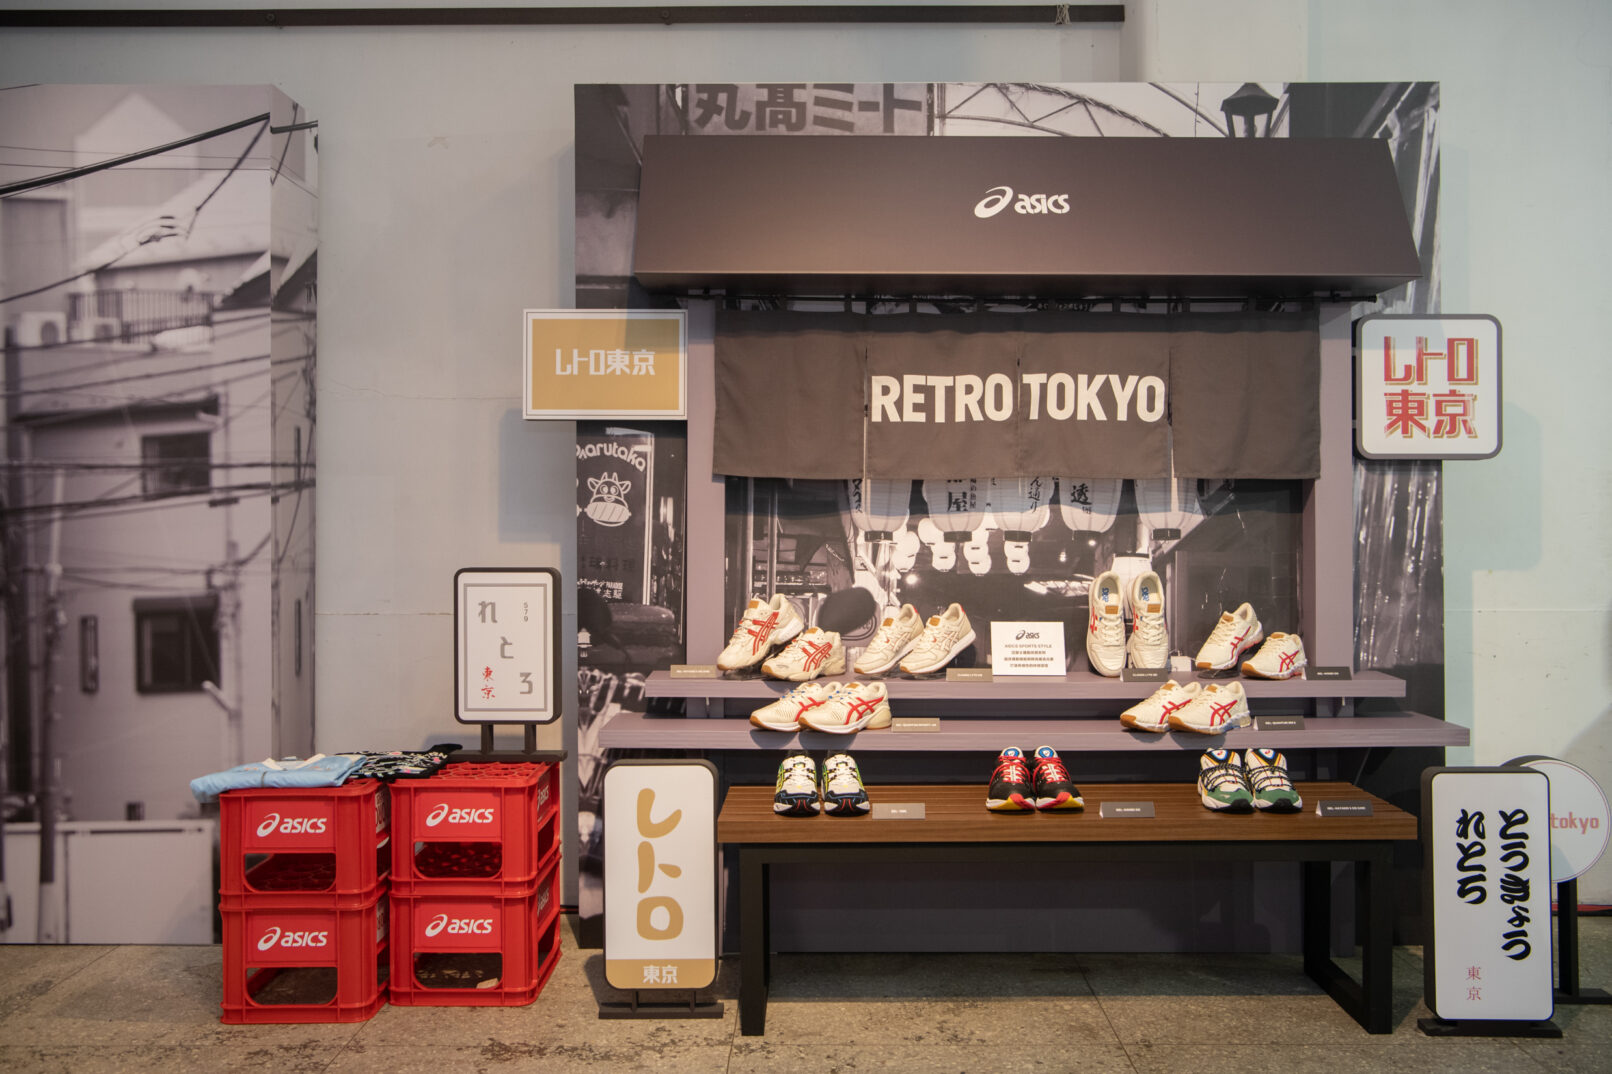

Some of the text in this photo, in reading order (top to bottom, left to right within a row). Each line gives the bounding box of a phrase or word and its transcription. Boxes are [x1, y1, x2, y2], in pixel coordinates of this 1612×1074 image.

[1014, 192, 1071, 215] asics
[555, 348, 656, 376] レトロ東京
[1383, 336, 1479, 386] レトロ
[870, 373, 1168, 424] RETRO TOKYO
[1383, 389, 1479, 440] 東京
[481, 666, 496, 699] 東京
[280, 817, 327, 834] asics
[446, 806, 495, 823] asics
[1551, 812, 1600, 835] tokyo
[637, 788, 684, 941] レトロ
[280, 930, 328, 947] asics
[446, 918, 493, 935] asics
[643, 966, 679, 984] 東京
[1466, 966, 1482, 1001] 東京
